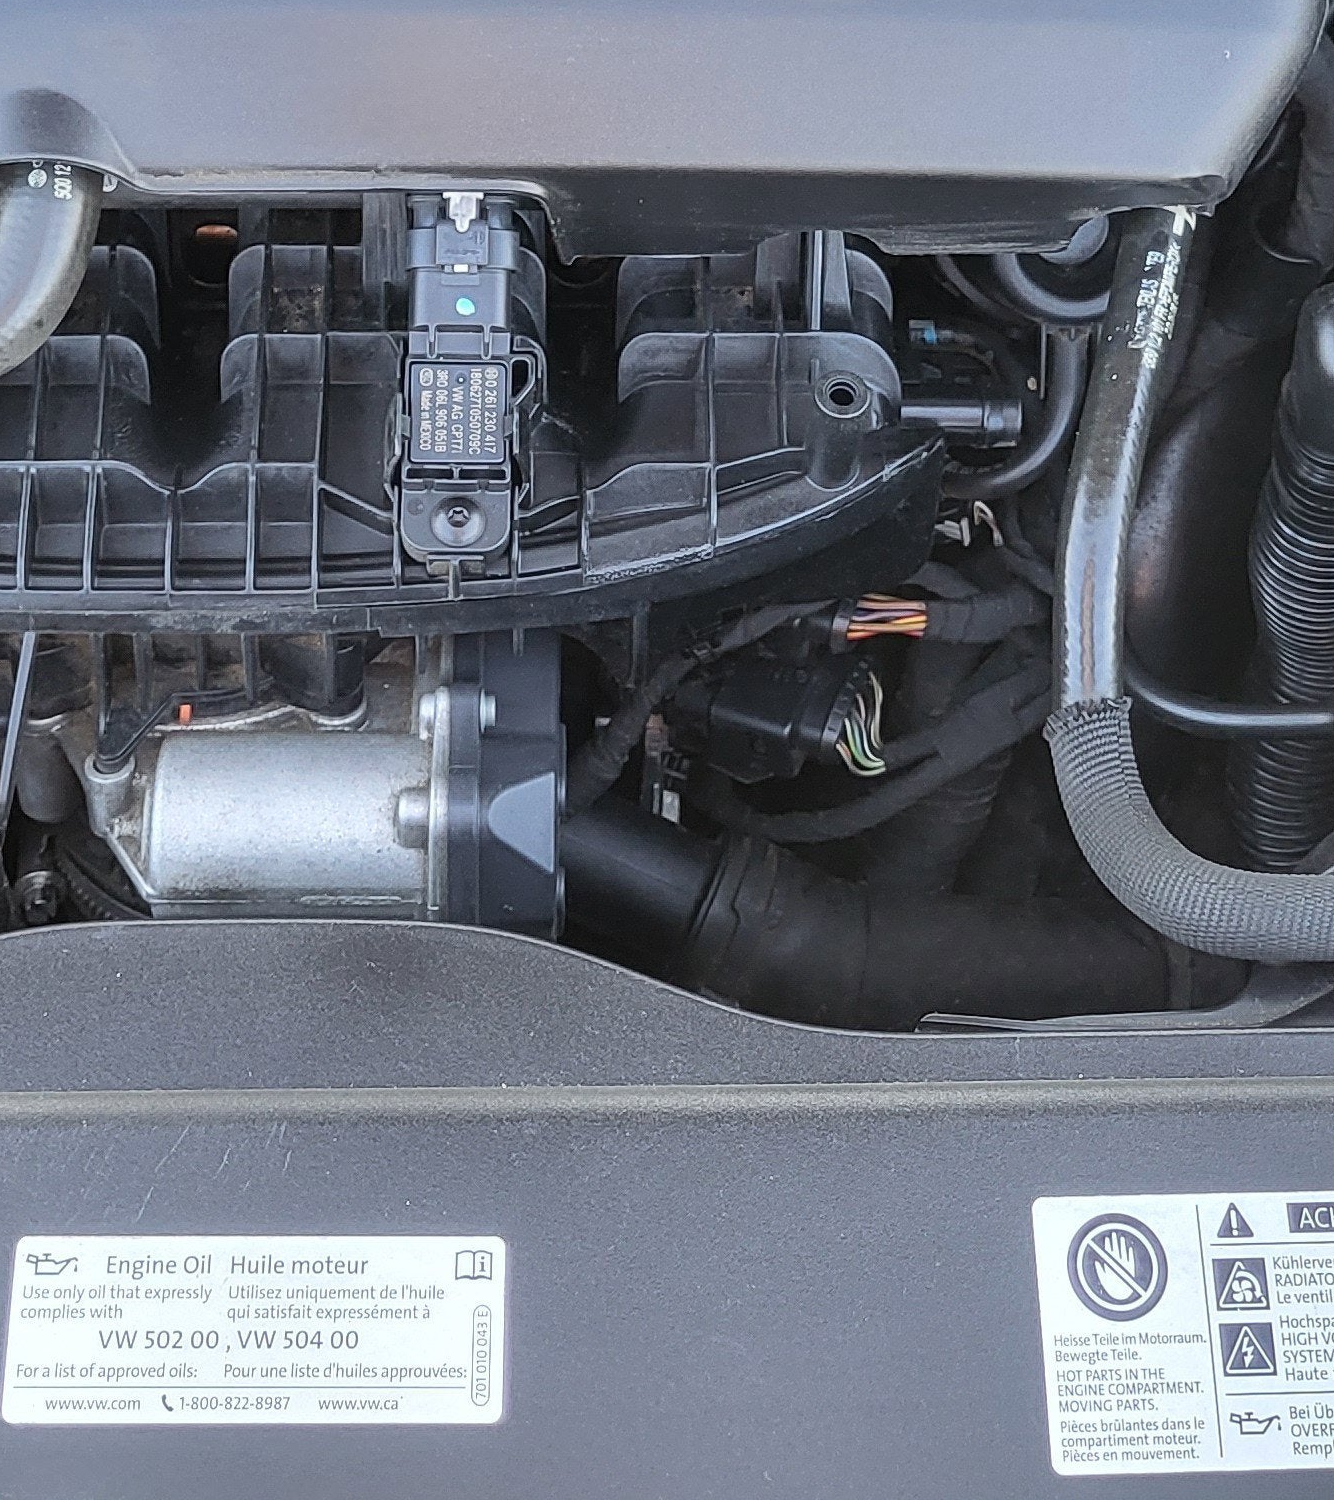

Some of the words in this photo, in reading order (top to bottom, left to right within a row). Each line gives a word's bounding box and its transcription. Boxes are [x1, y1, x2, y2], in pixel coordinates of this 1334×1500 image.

[420, 390, 432, 410] Made
[452, 386, 463, 402] VW
[485, 390, 497, 407] 261
[452, 404, 463, 420] AG
[484, 411, 496, 431] 230
[420, 420, 431, 451] MEXICO
[484, 435, 496, 453] 417
[106, 1255, 176, 1280] Engine
[183, 1255, 211, 1275] Oil
[230, 1255, 284, 1275] Huile
[291, 1255, 368, 1275] moteur
[22, 1285, 49, 1300] Use
[53, 1285, 84, 1305] only
[88, 1285, 105, 1300] oil
[110, 1285, 140, 1300] that
[144, 1285, 212, 1305] expressly
[228, 1285, 281, 1300] Utilisez
[286, 1285, 375, 1305] uniquement
[379, 1285, 397, 1300] de
[401, 1285, 444, 1300] l'huile
[20, 1304, 85, 1324] complies
[89, 1304, 122, 1319] with
[226, 1304, 249, 1324] qui
[254, 1304, 312, 1320] satisfait
[315, 1304, 418, 1324] expressément
[422, 1304, 429, 1320] à
[98, 1330, 137, 1349] VW
[144, 1330, 182, 1349] 502
[237, 1330, 276, 1349] VW
[283, 1330, 323, 1349] 504
[330, 1330, 358, 1349] 00
[476, 1322, 488, 1347] 043
[1054, 1334, 1090, 1347] Heisse
[1092, 1333, 1119, 1347] Teile
[1121, 1333, 1136, 1346] im
[1139, 1332, 1207, 1345] Motorraum.
[1281, 1331, 1318, 1346] HIGH
[475, 1350, 488, 1373] 010
[1055, 1349, 1108, 1366] Bewegte
[1110, 1348, 1142, 1361] Teile.
[16, 1363, 39, 1378] For
[41, 1367, 50, 1378] a
[54, 1363, 75, 1378] list
[79, 1363, 94, 1378] of
[97, 1363, 165, 1383] approved
[168, 1363, 197, 1378] oils:
[224, 1363, 256, 1378] Pour
[260, 1366, 288, 1379] une
[290, 1363, 319, 1378] liste
[323, 1363, 378, 1379] d'huiles
[381, 1363, 468, 1383] approuvées:
[1056, 1369, 1082, 1383] HOT
[1085, 1368, 1121, 1382] PARTS
[1124, 1368, 1138, 1381] IN
[1140, 1367, 1164, 1380] THE
[475, 1377, 487, 1399] 701
[1057, 1383, 1104, 1397] ENGINE
[1108, 1381, 1203, 1396] COMPARTMENT.
[45, 1398, 140, 1410] www.vw.com
[179, 1395, 290, 1410] 1-800-822-8987
[318, 1398, 398, 1410] www.vw.ca
[1058, 1399, 1112, 1413] MOVING
[1116, 1398, 1158, 1412] PARTS.
[1289, 1404, 1310, 1420] Bei
[1060, 1419, 1097, 1433] Pièces
[1100, 1417, 1158, 1432] brûlantes
[1161, 1417, 1190, 1431] dans
[1193, 1416, 1204, 1430] le
[1061, 1432, 1149, 1451] compartiment
[1152, 1431, 1200, 1446] moteur.
